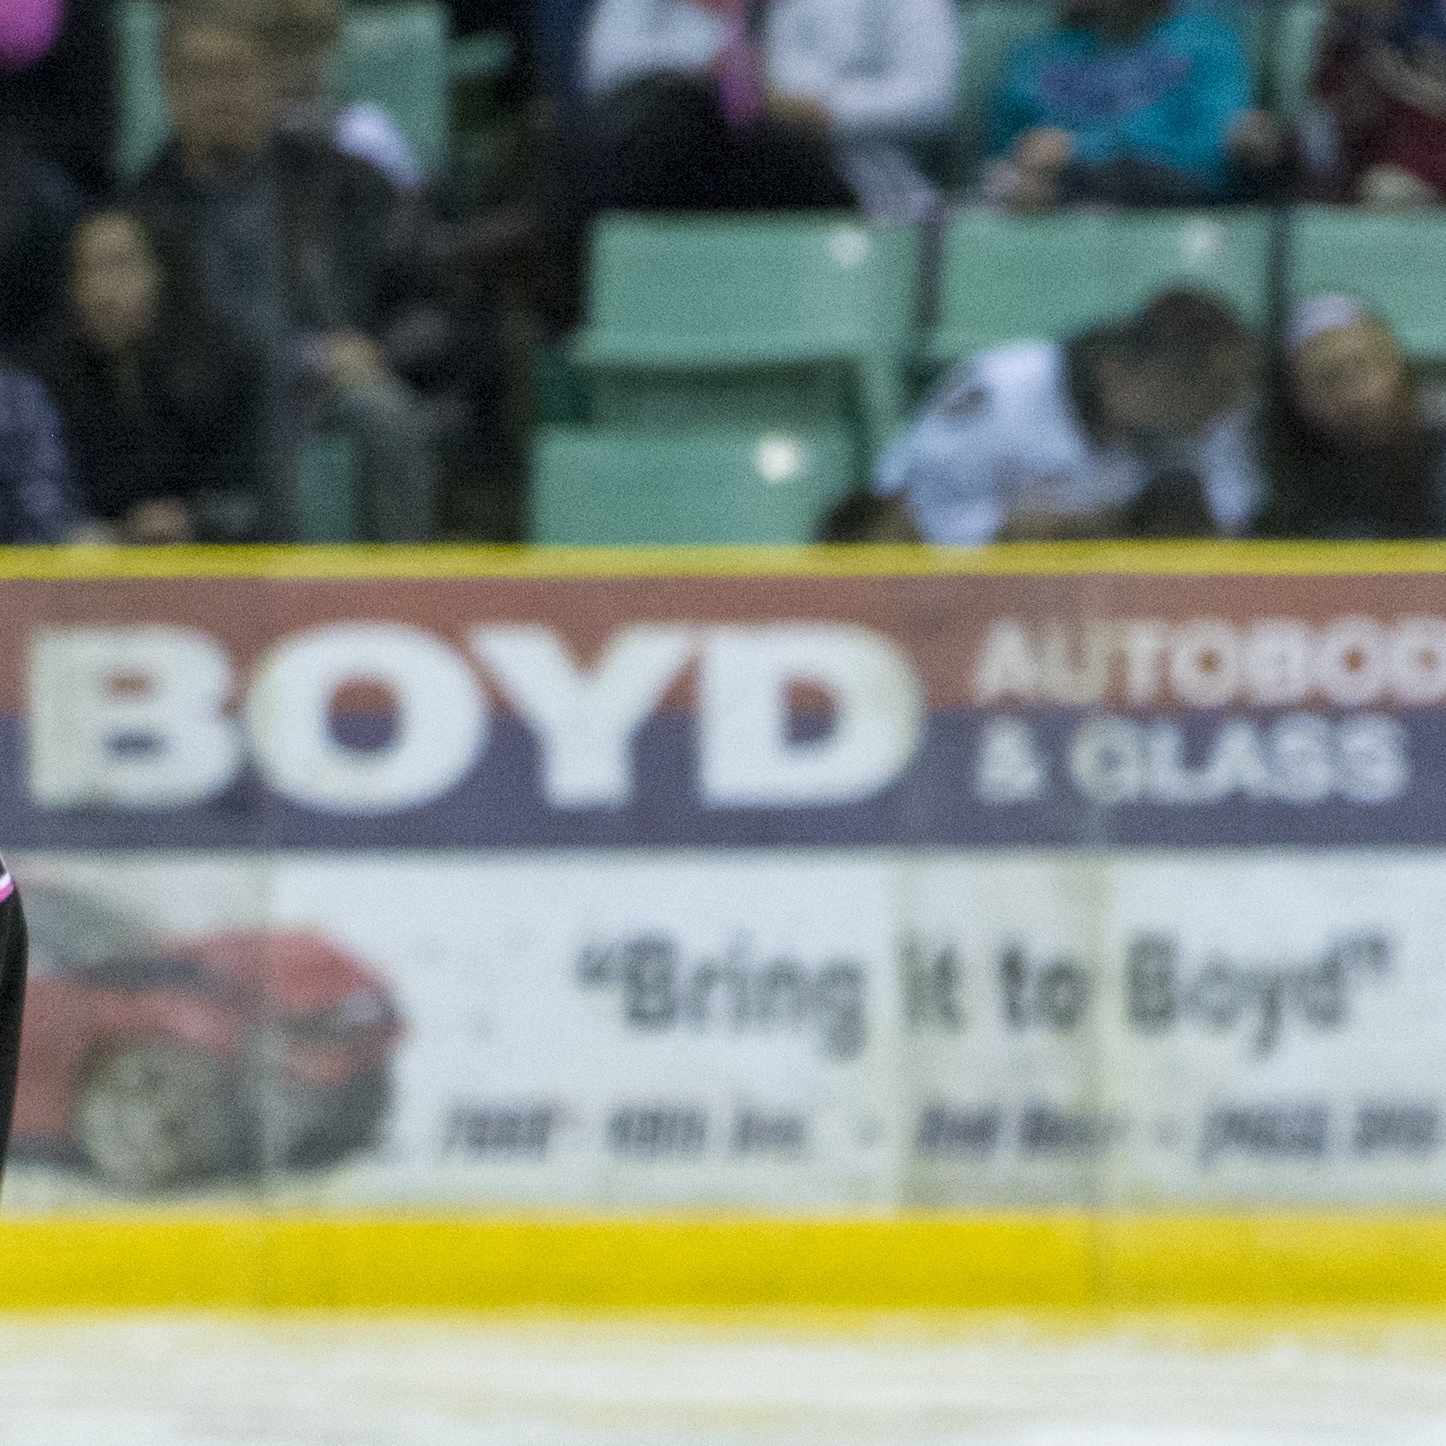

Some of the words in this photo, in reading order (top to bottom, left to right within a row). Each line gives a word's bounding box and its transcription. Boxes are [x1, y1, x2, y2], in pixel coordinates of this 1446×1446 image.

[24, 618, 925, 812] BOYD
[977, 714, 1046, 804] &
[1069, 712, 1407, 804] GLASS
